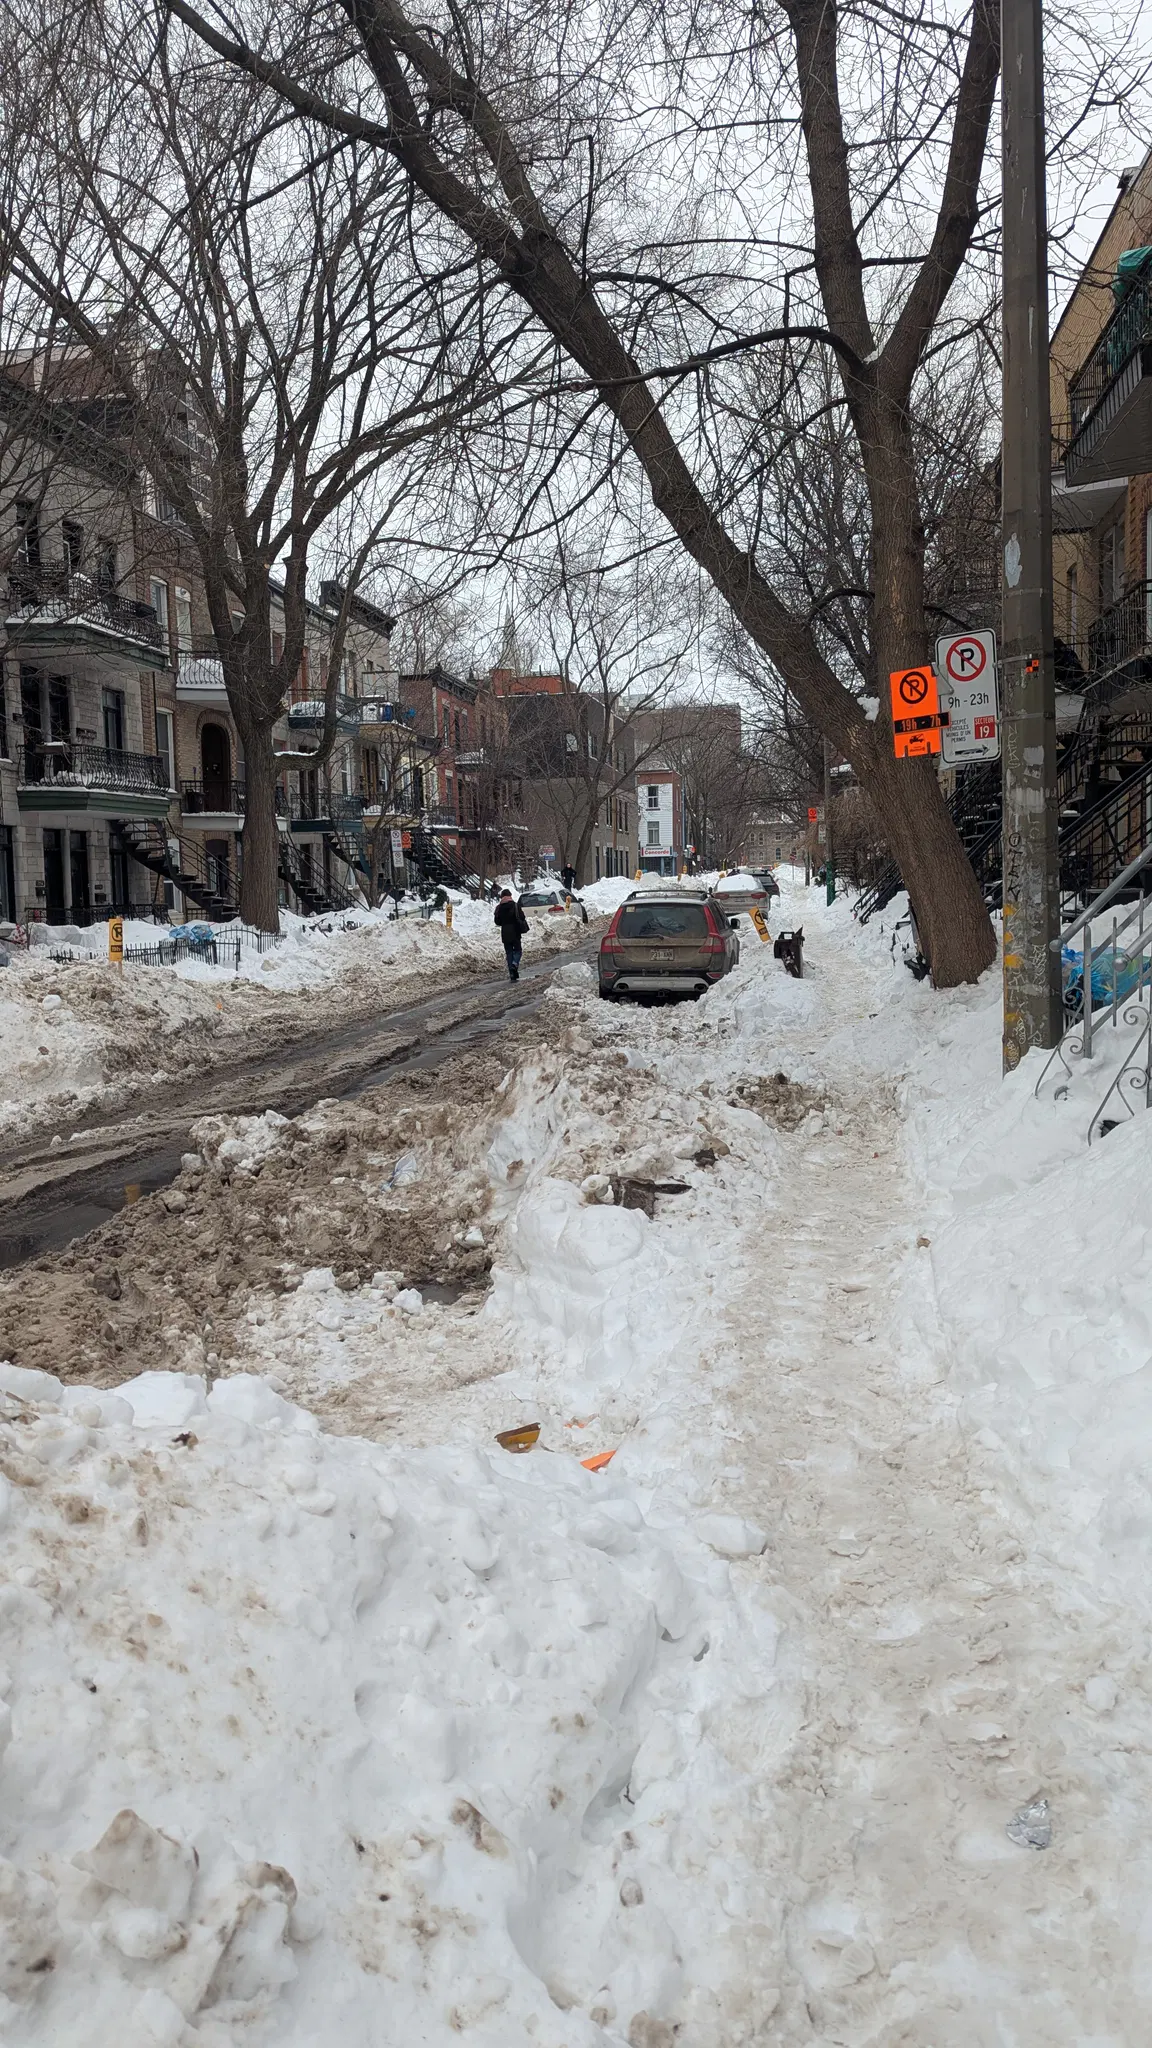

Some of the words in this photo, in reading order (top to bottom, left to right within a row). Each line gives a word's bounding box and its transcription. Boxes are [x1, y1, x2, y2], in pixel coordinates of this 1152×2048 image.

[948, 696, 960, 708] 9h
[970, 692, 989, 706] 23h
[901, 718, 917, 731] 19h
[930, 715, 941, 727] 7h
[974, 716, 994, 725] SECTEUR
[980, 725, 990, 738] 19
